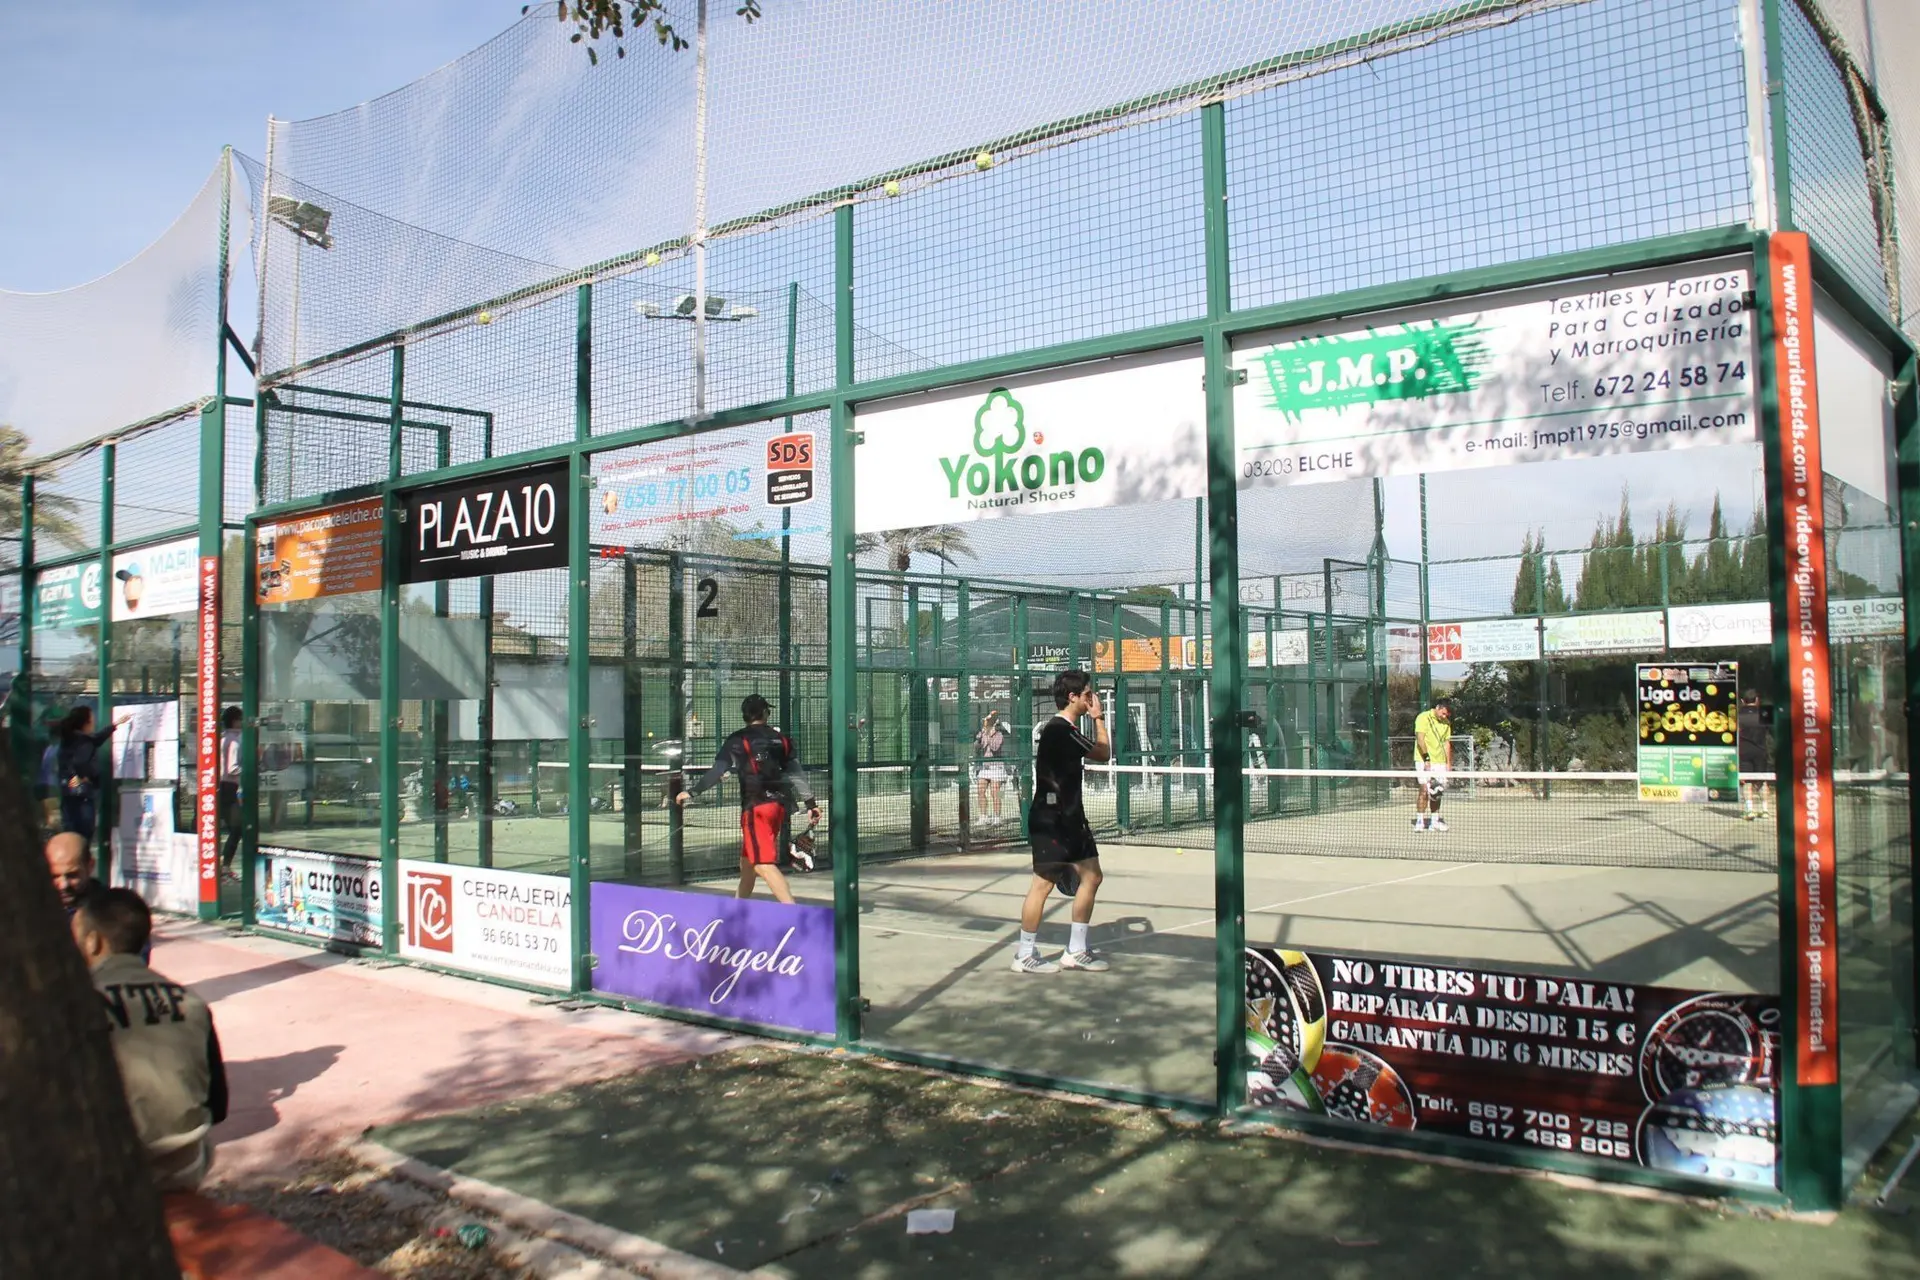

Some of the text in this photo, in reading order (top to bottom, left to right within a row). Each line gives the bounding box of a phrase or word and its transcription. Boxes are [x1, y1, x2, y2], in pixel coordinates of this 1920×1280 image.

[1550, 275, 1740, 315] Textiles y Forros
[1549, 298, 1742, 338] Para Calzado
[1550, 319, 1742, 365] y Marroquinería
[1299, 348, 1426, 395] J.M.P.
[1540, 360, 1746, 403] Telf. 672 24 58 74
[1782, 264, 1809, 483] www.seguridadsds.com
[1465, 412, 1746, 453] e-mail: jmpt1975@gmail.com
[770, 442, 810, 463] SDS
[1243, 452, 1353, 478] 03203 ELCHE
[623, 482, 657, 510] 658
[664, 477, 687, 505] 77
[694, 473, 718, 499] 00
[725, 466, 751, 494] 05
[939, 447, 1105, 499] Yokono
[967, 490, 1075, 510] Natural Shoes
[1794, 504, 1817, 648] videovigilancia
[697, 578, 718, 618] 2
[1853, 602, 1865, 614] el
[939, 689, 1010, 700] GLOAL CARE
[1640, 685, 1701, 705] Liga de
[1640, 703, 1737, 738] pádel
[1802, 666, 1821, 831] central receptora
[201, 767, 215, 791] Tel.
[202, 794, 215, 812] 96
[202, 814, 215, 839] 542
[202, 842, 215, 859] 23
[202, 862, 215, 879] 76
[463, 879, 571, 908] CERRAJERÍA
[477, 902, 562, 929] CANDELA
[482, 928, 558, 953] 96 661 53 70
[618, 909, 804, 1005] D'Angela
[1804, 850, 1827, 1052] seguridad perimetral
[1332, 959, 1635, 1013] NO TIRES TU PALA!
[1476, 1006, 1567, 1038] DESDE
[1577, 1018, 1609, 1042] 15
[1616, 1022, 1636, 1046] €
[1331, 1019, 1464, 1056] GARANTÍA
[1471, 1036, 1507, 1061] DE
[1513, 1042, 1531, 1064] 6
[1537, 1044, 1634, 1077] MESES
[1416, 1093, 1459, 1113] Telf.
[1468, 1101, 1513, 1121] 667
[1523, 1109, 1570, 1130] 700
[1469, 1120, 1631, 1158] 617 483 805
